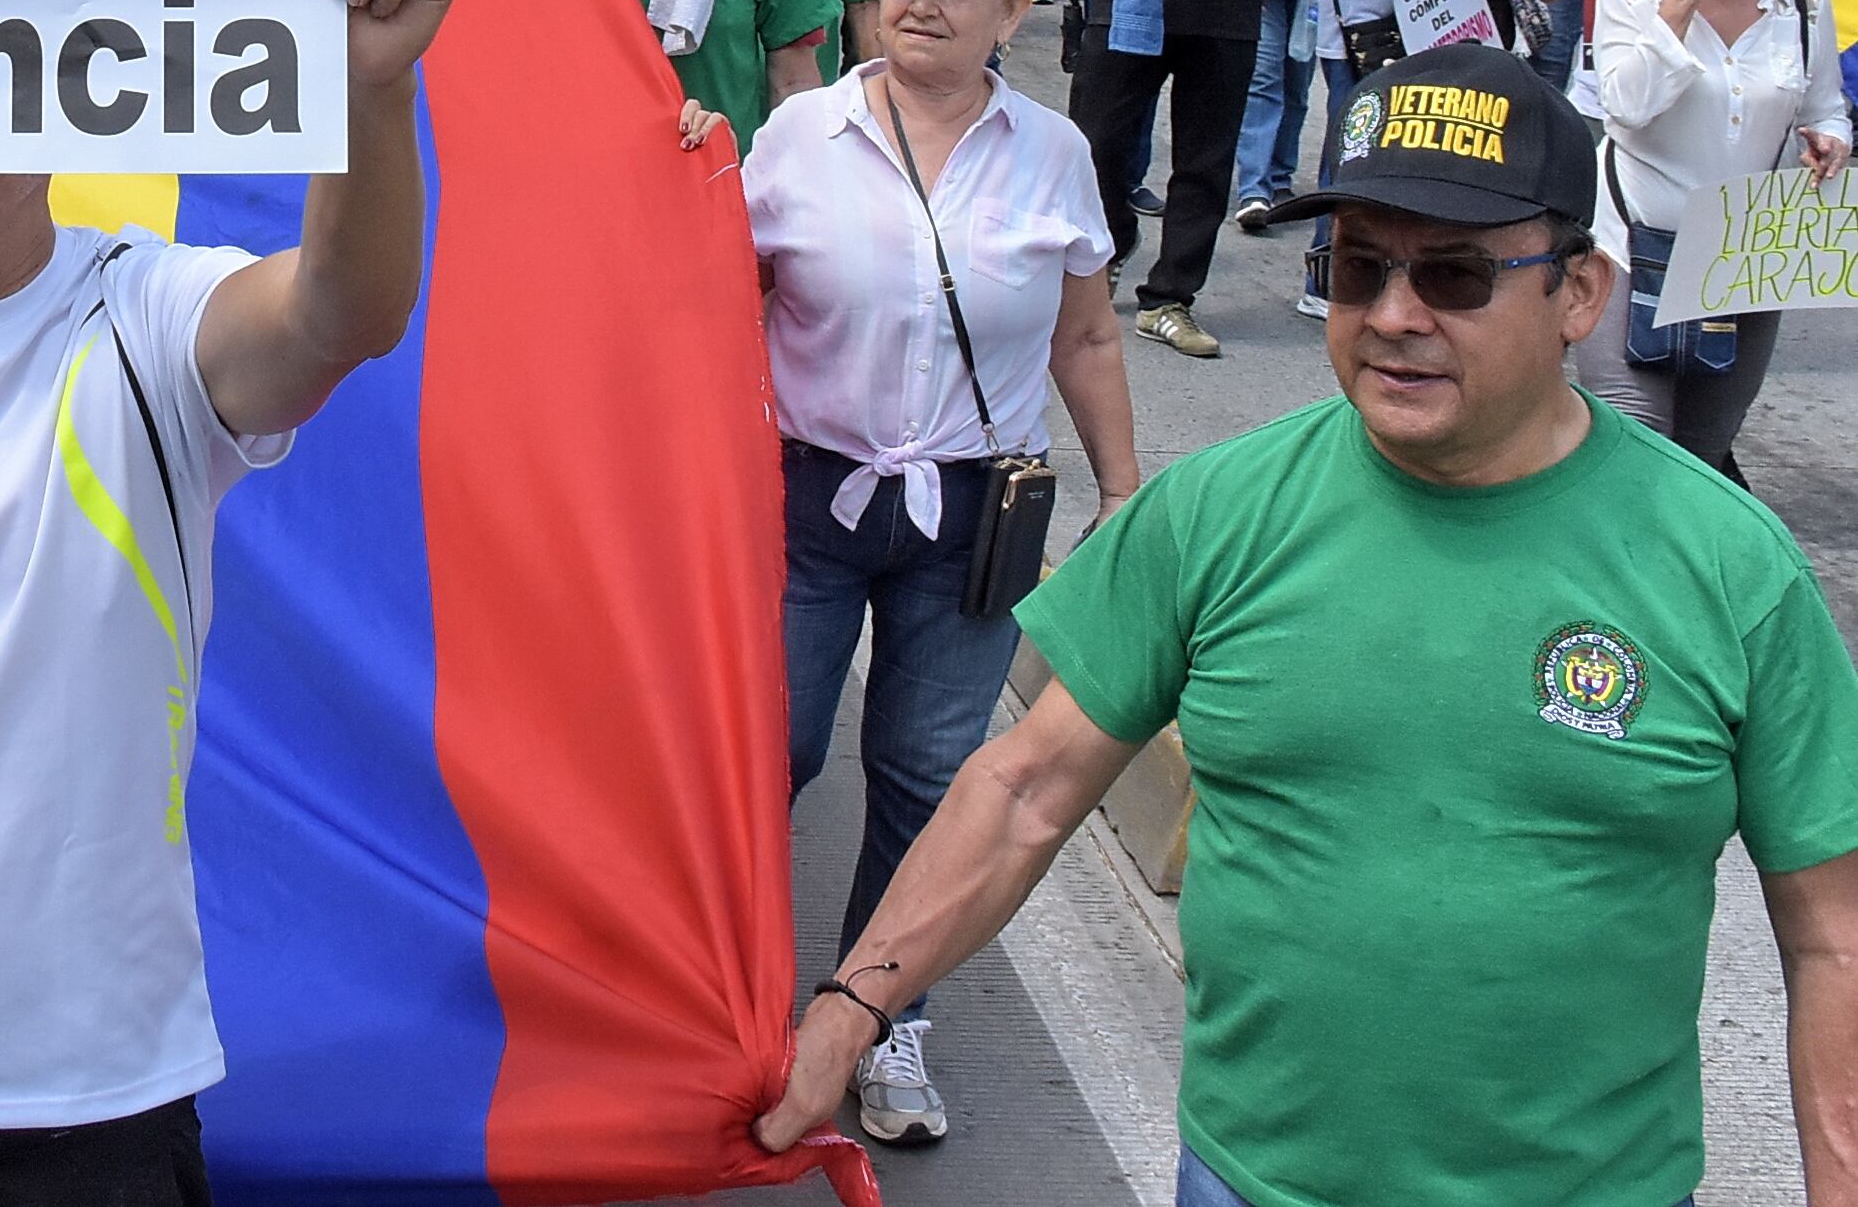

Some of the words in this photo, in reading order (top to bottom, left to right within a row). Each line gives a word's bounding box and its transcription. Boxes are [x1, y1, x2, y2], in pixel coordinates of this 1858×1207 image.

[1431, 9, 1455, 32] DEL
[1389, 85, 1510, 128] VETERANO
[1380, 119, 1504, 165] POLICIA
[1722, 205, 1858, 255] LIBERTA
